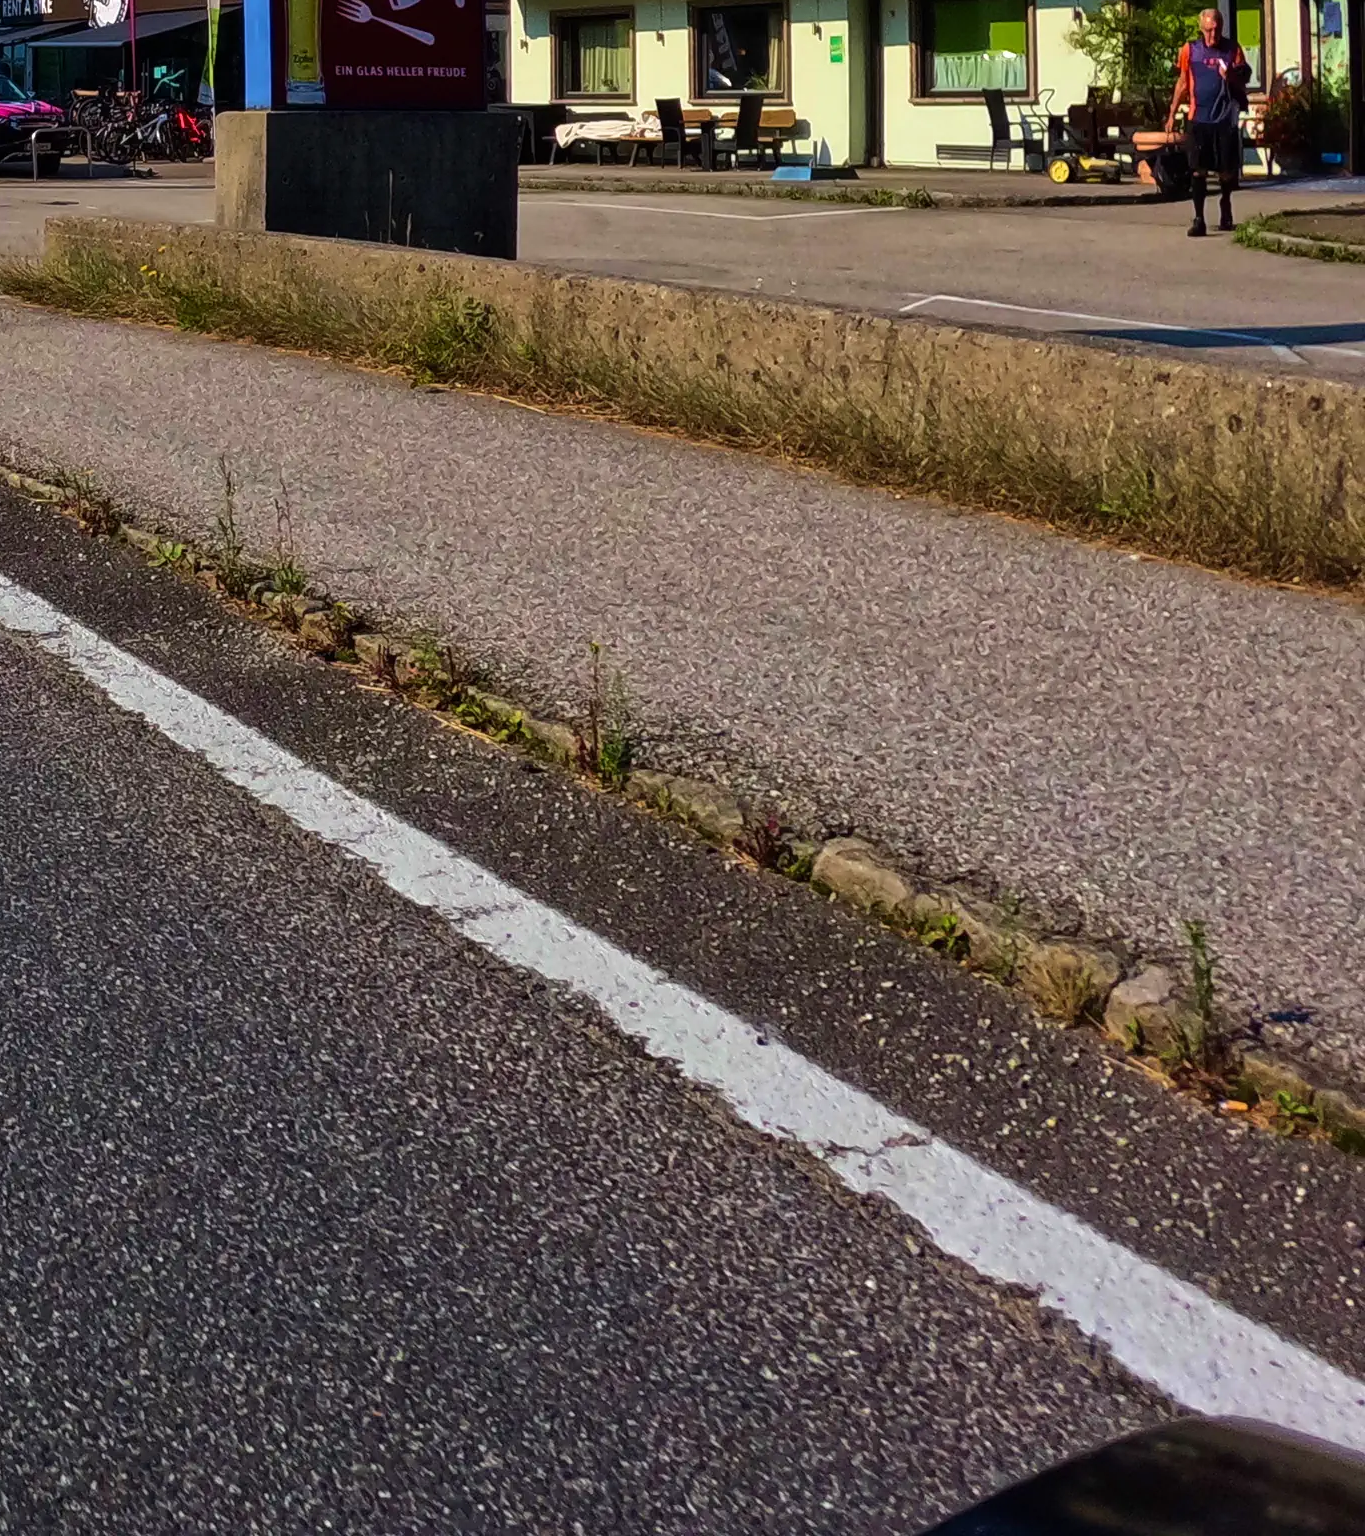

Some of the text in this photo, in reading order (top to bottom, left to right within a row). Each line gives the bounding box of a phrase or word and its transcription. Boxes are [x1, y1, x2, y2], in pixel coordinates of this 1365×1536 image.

[335, 65, 468, 78] EIN GLAS HELLER FREUDE
